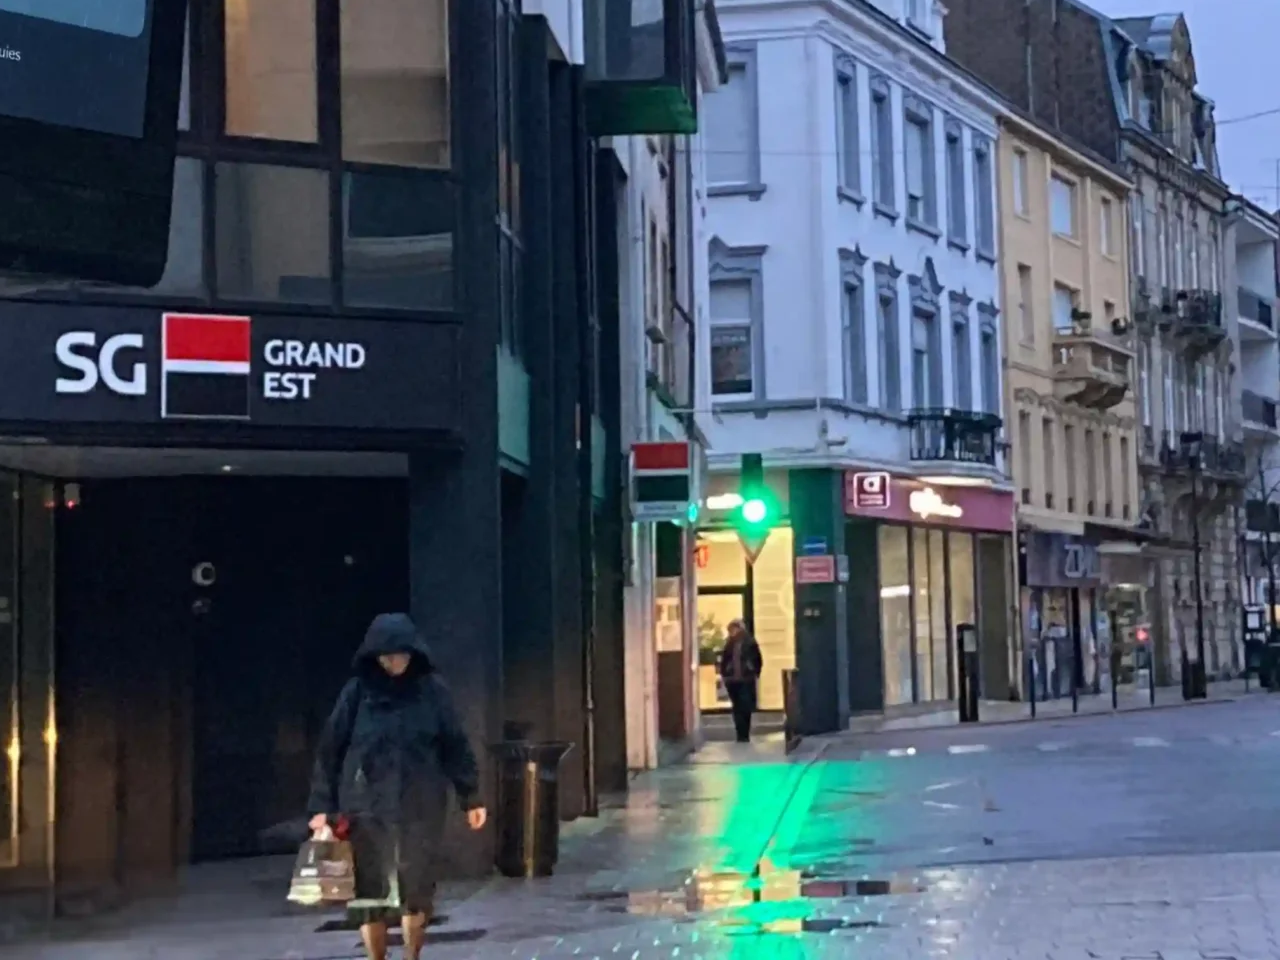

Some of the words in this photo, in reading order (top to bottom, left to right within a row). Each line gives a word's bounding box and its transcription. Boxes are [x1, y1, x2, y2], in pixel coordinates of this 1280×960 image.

[54, 331, 147, 396] SG
[263, 339, 366, 370] GRAND
[263, 372, 317, 399] EST
